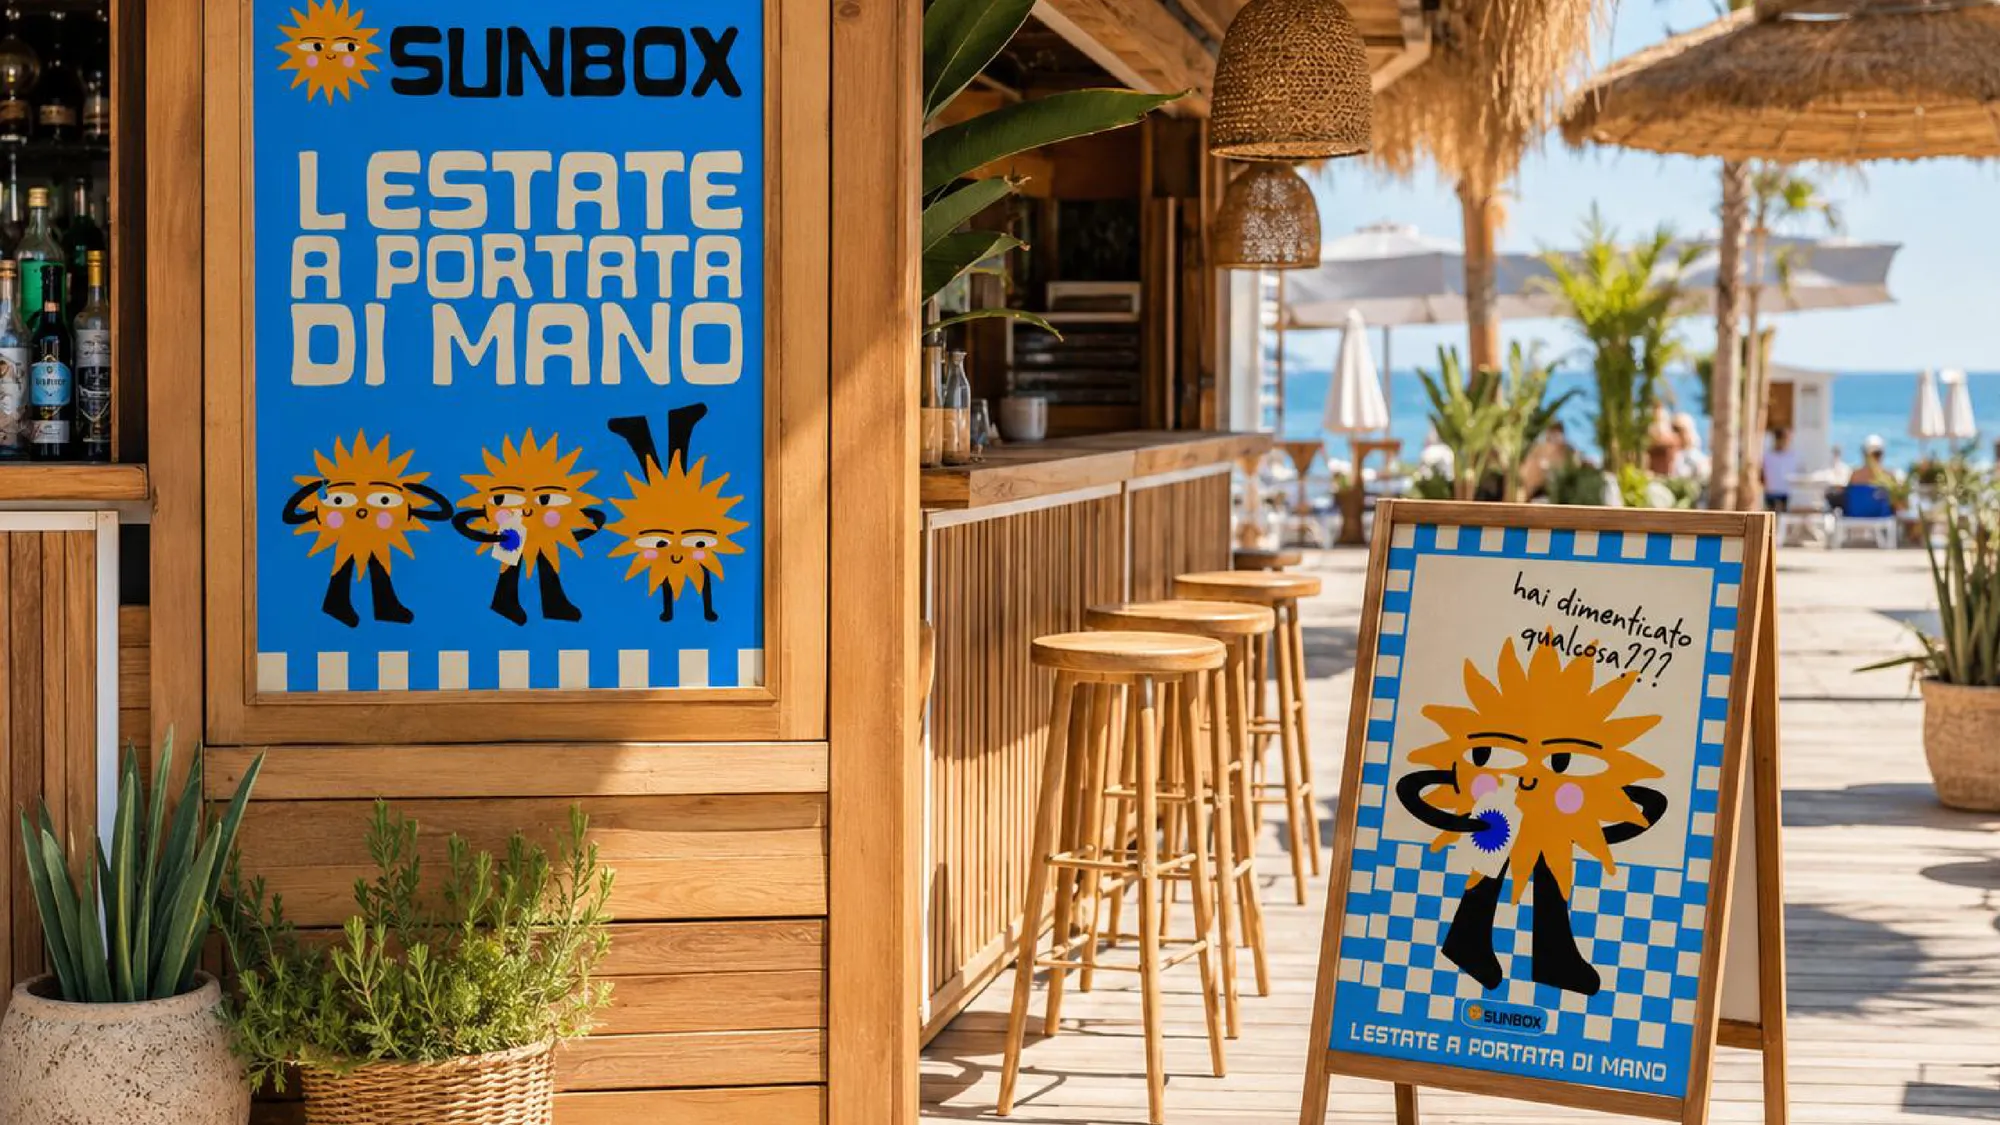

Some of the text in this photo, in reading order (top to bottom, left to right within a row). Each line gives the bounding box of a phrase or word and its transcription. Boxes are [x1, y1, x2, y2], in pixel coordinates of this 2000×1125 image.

[390, 26, 742, 97] SUNBOX
[299, 150, 743, 230] L ESTATE
[291, 233, 742, 299] A PORTATA
[291, 302, 743, 386] DI MANO
[1513, 571, 1692, 648] hai dimenticato
[1521, 625, 1672, 687] qualcosa???
[1484, 1010, 1541, 1029] SUNBOX
[1446, 1035, 1461, 1055] A
[1468, 1037, 1565, 1068] PORTATA
[1572, 1052, 1593, 1072] DI
[1601, 1056, 1667, 1082] MANO
